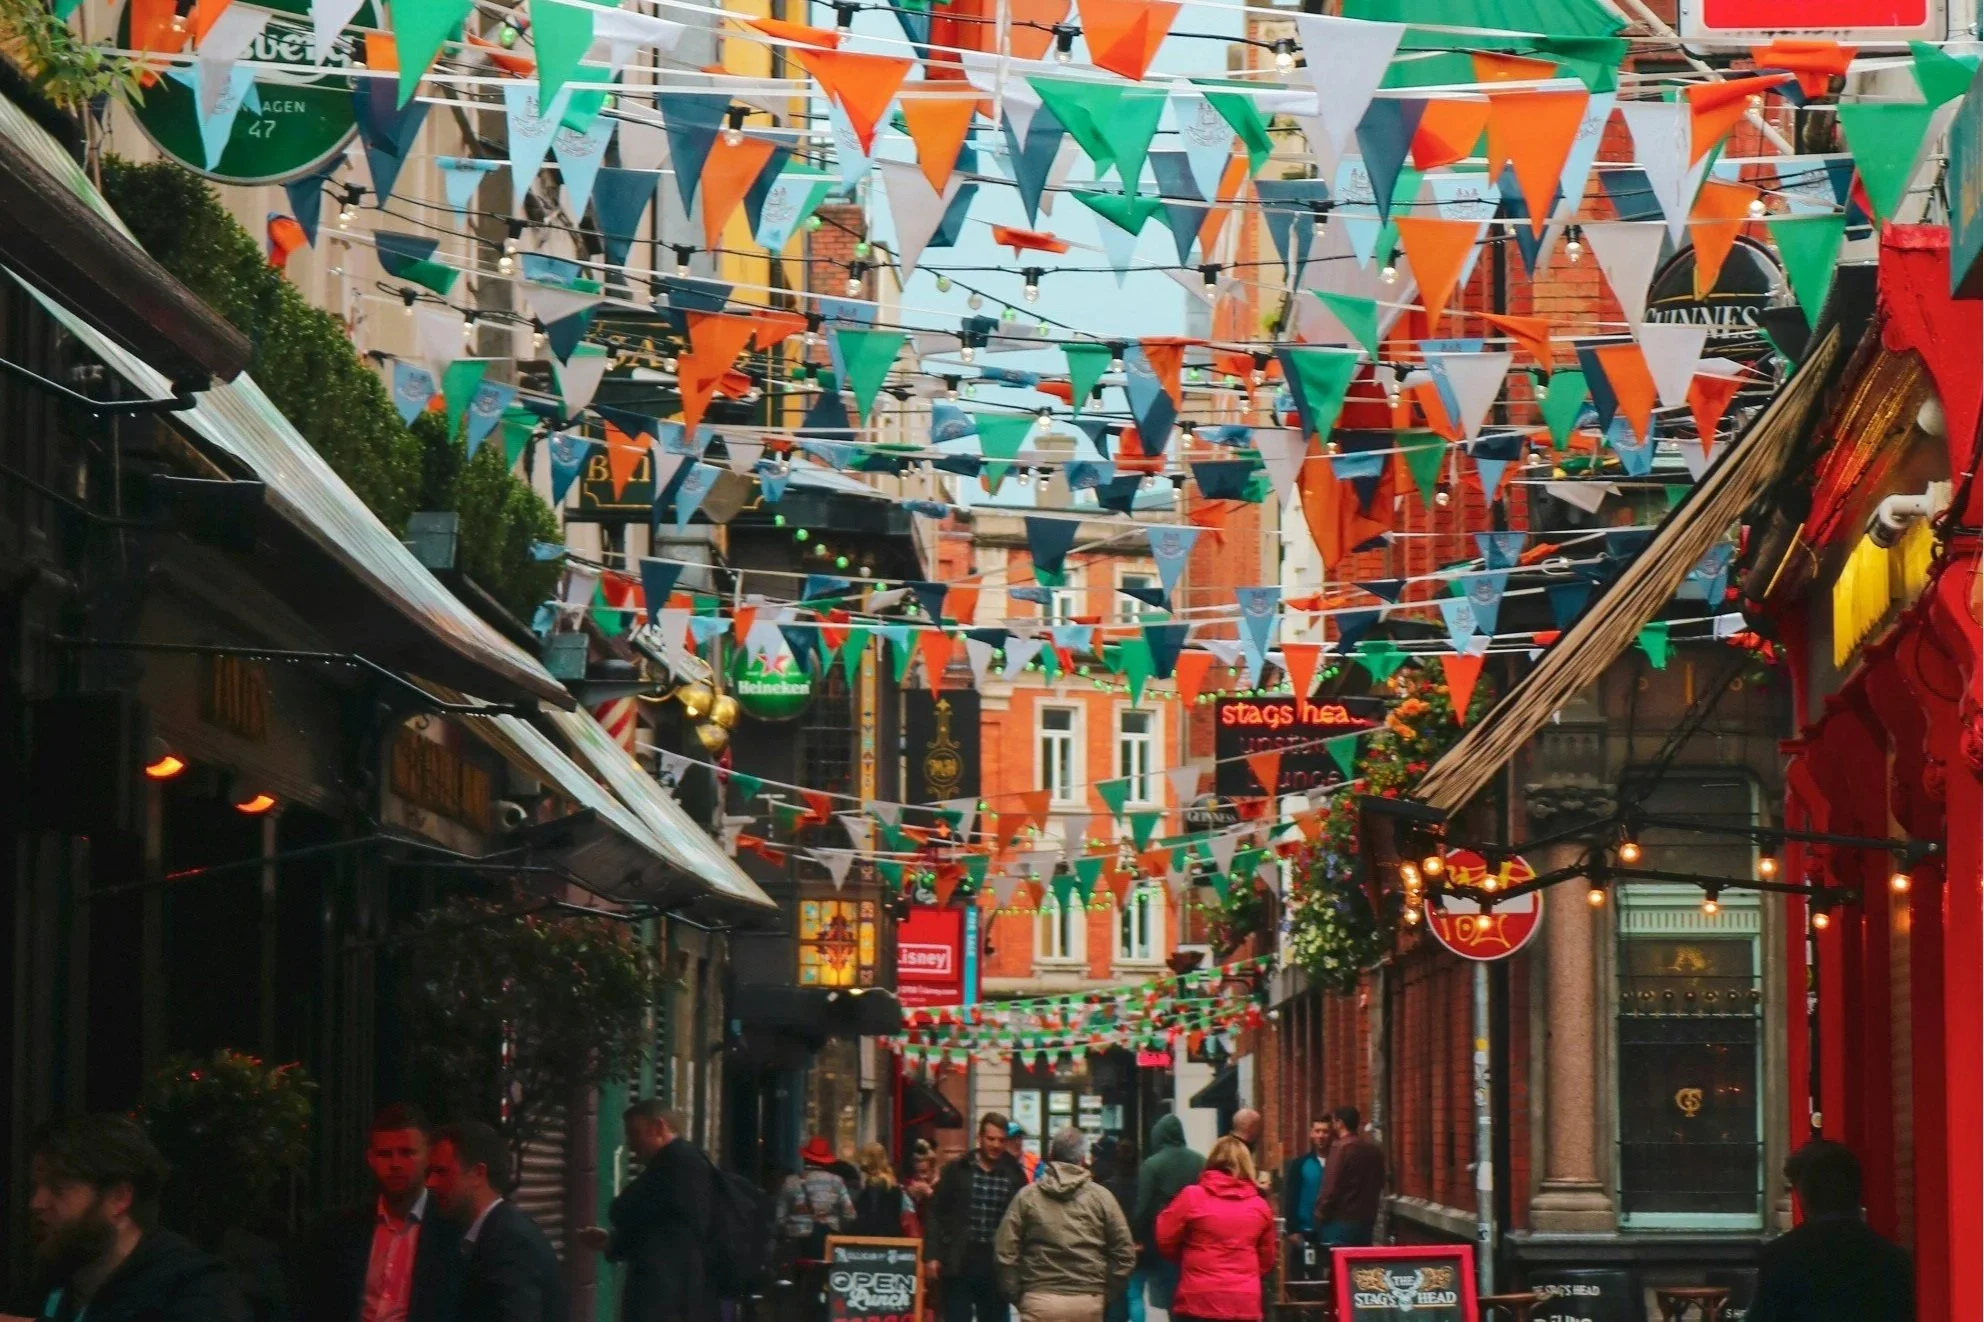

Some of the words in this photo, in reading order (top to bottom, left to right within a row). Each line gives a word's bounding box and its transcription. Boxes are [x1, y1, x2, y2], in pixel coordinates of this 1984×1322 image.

[248, 120, 276, 138] 47
[1643, 305, 1760, 339] GUINNES
[738, 680, 811, 695] Heineken
[1222, 703, 1294, 728] stags
[898, 948, 947, 969] isney
[829, 1271, 917, 1294] OPEN
[1391, 1275, 1416, 1286] THE
[846, 1286, 911, 1311] Lunch
[1417, 1291, 1457, 1304] HEAD
